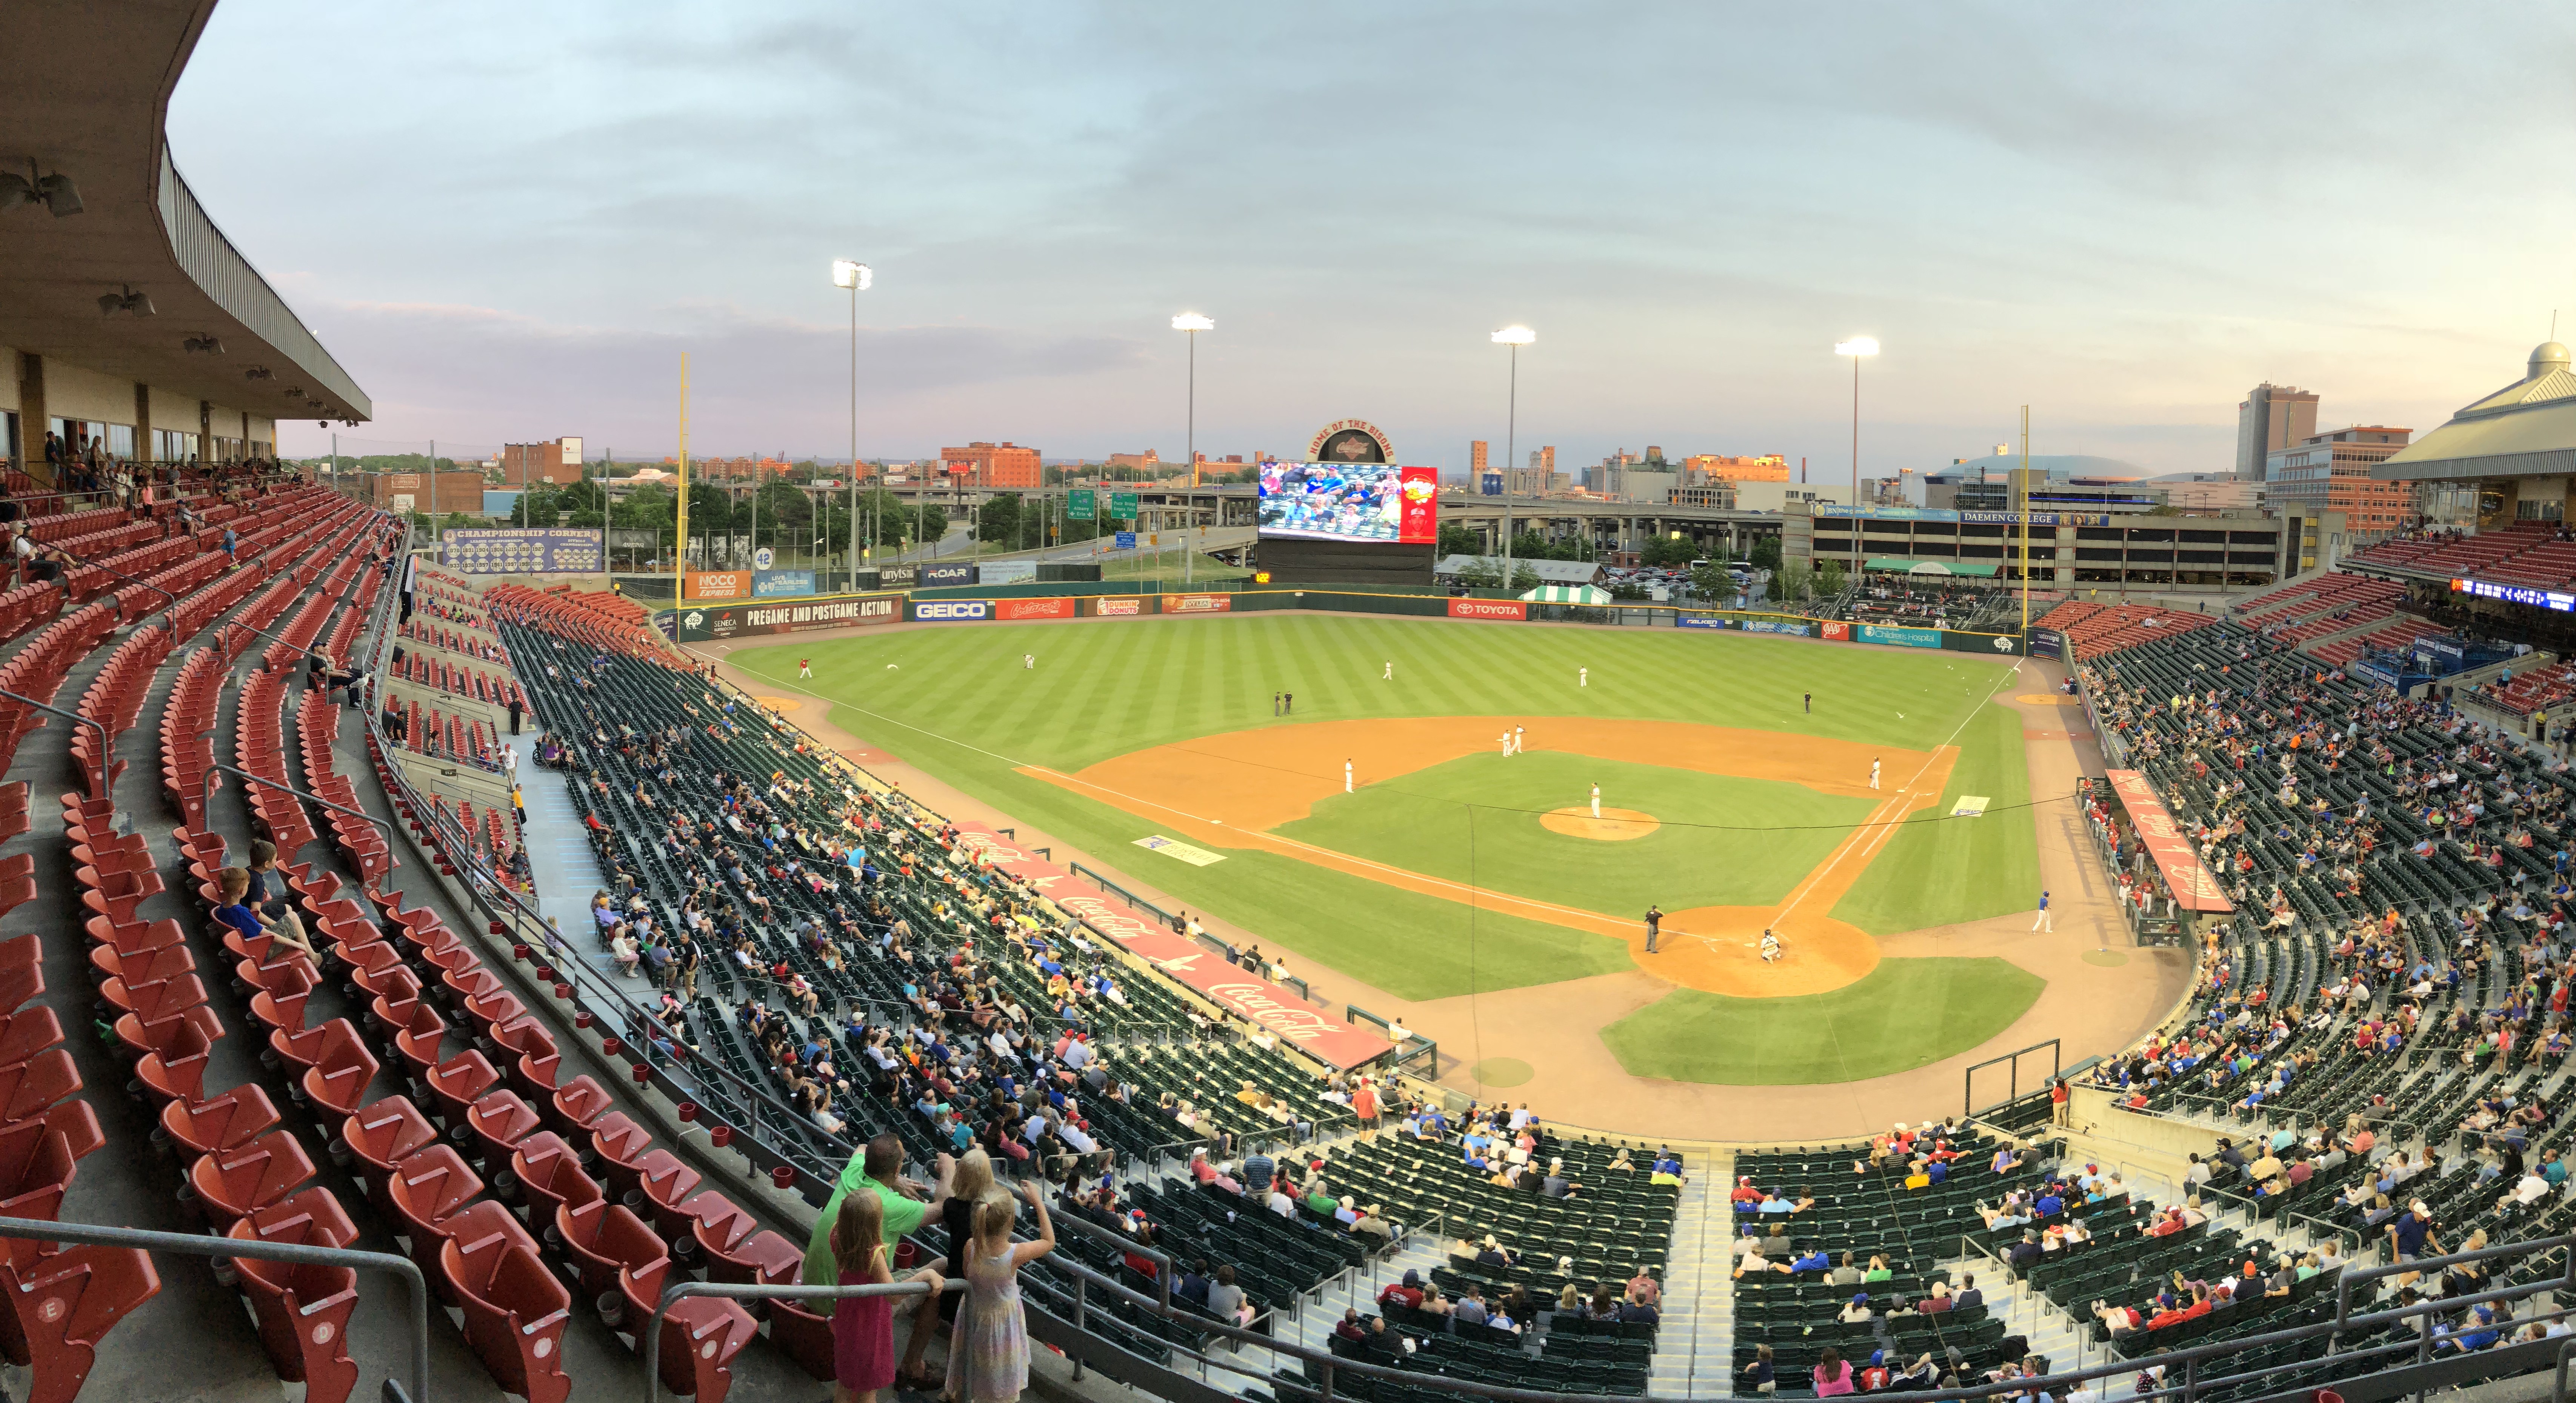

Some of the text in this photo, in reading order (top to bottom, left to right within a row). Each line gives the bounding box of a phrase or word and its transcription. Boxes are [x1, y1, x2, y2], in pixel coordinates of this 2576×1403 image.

[1310, 420, 1394, 457] HOME OF THE BISONS
[1964, 513, 2006, 522] DAEMEN
[697, 552, 703, 563] 6
[717, 551, 726, 563] 25
[739, 551, 748, 562] 30
[757, 553, 770, 565] 42
[699, 575, 736, 586] NOCO
[882, 568, 906, 582] unyts
[748, 601, 892, 626] PREGAME AND POSTGAME ACTION
[916, 603, 985, 618] GEICO
[1475, 605, 1519, 616] TOYOTA
[1875, 630, 1935, 643] Children's Hospital
[2037, 633, 2059, 643] nationalgrid
[2137, 813, 2181, 838] Coca-Cola
[1159, 847, 1186, 858] PARK
[2168, 863, 2221, 899] Coca-Cola
[1059, 897, 1162, 938] Coca-Cola
[1207, 983, 1347, 1040] Coca-Cola
[46, 1302, 57, 1317] E
[320, 1326, 328, 1339] D
